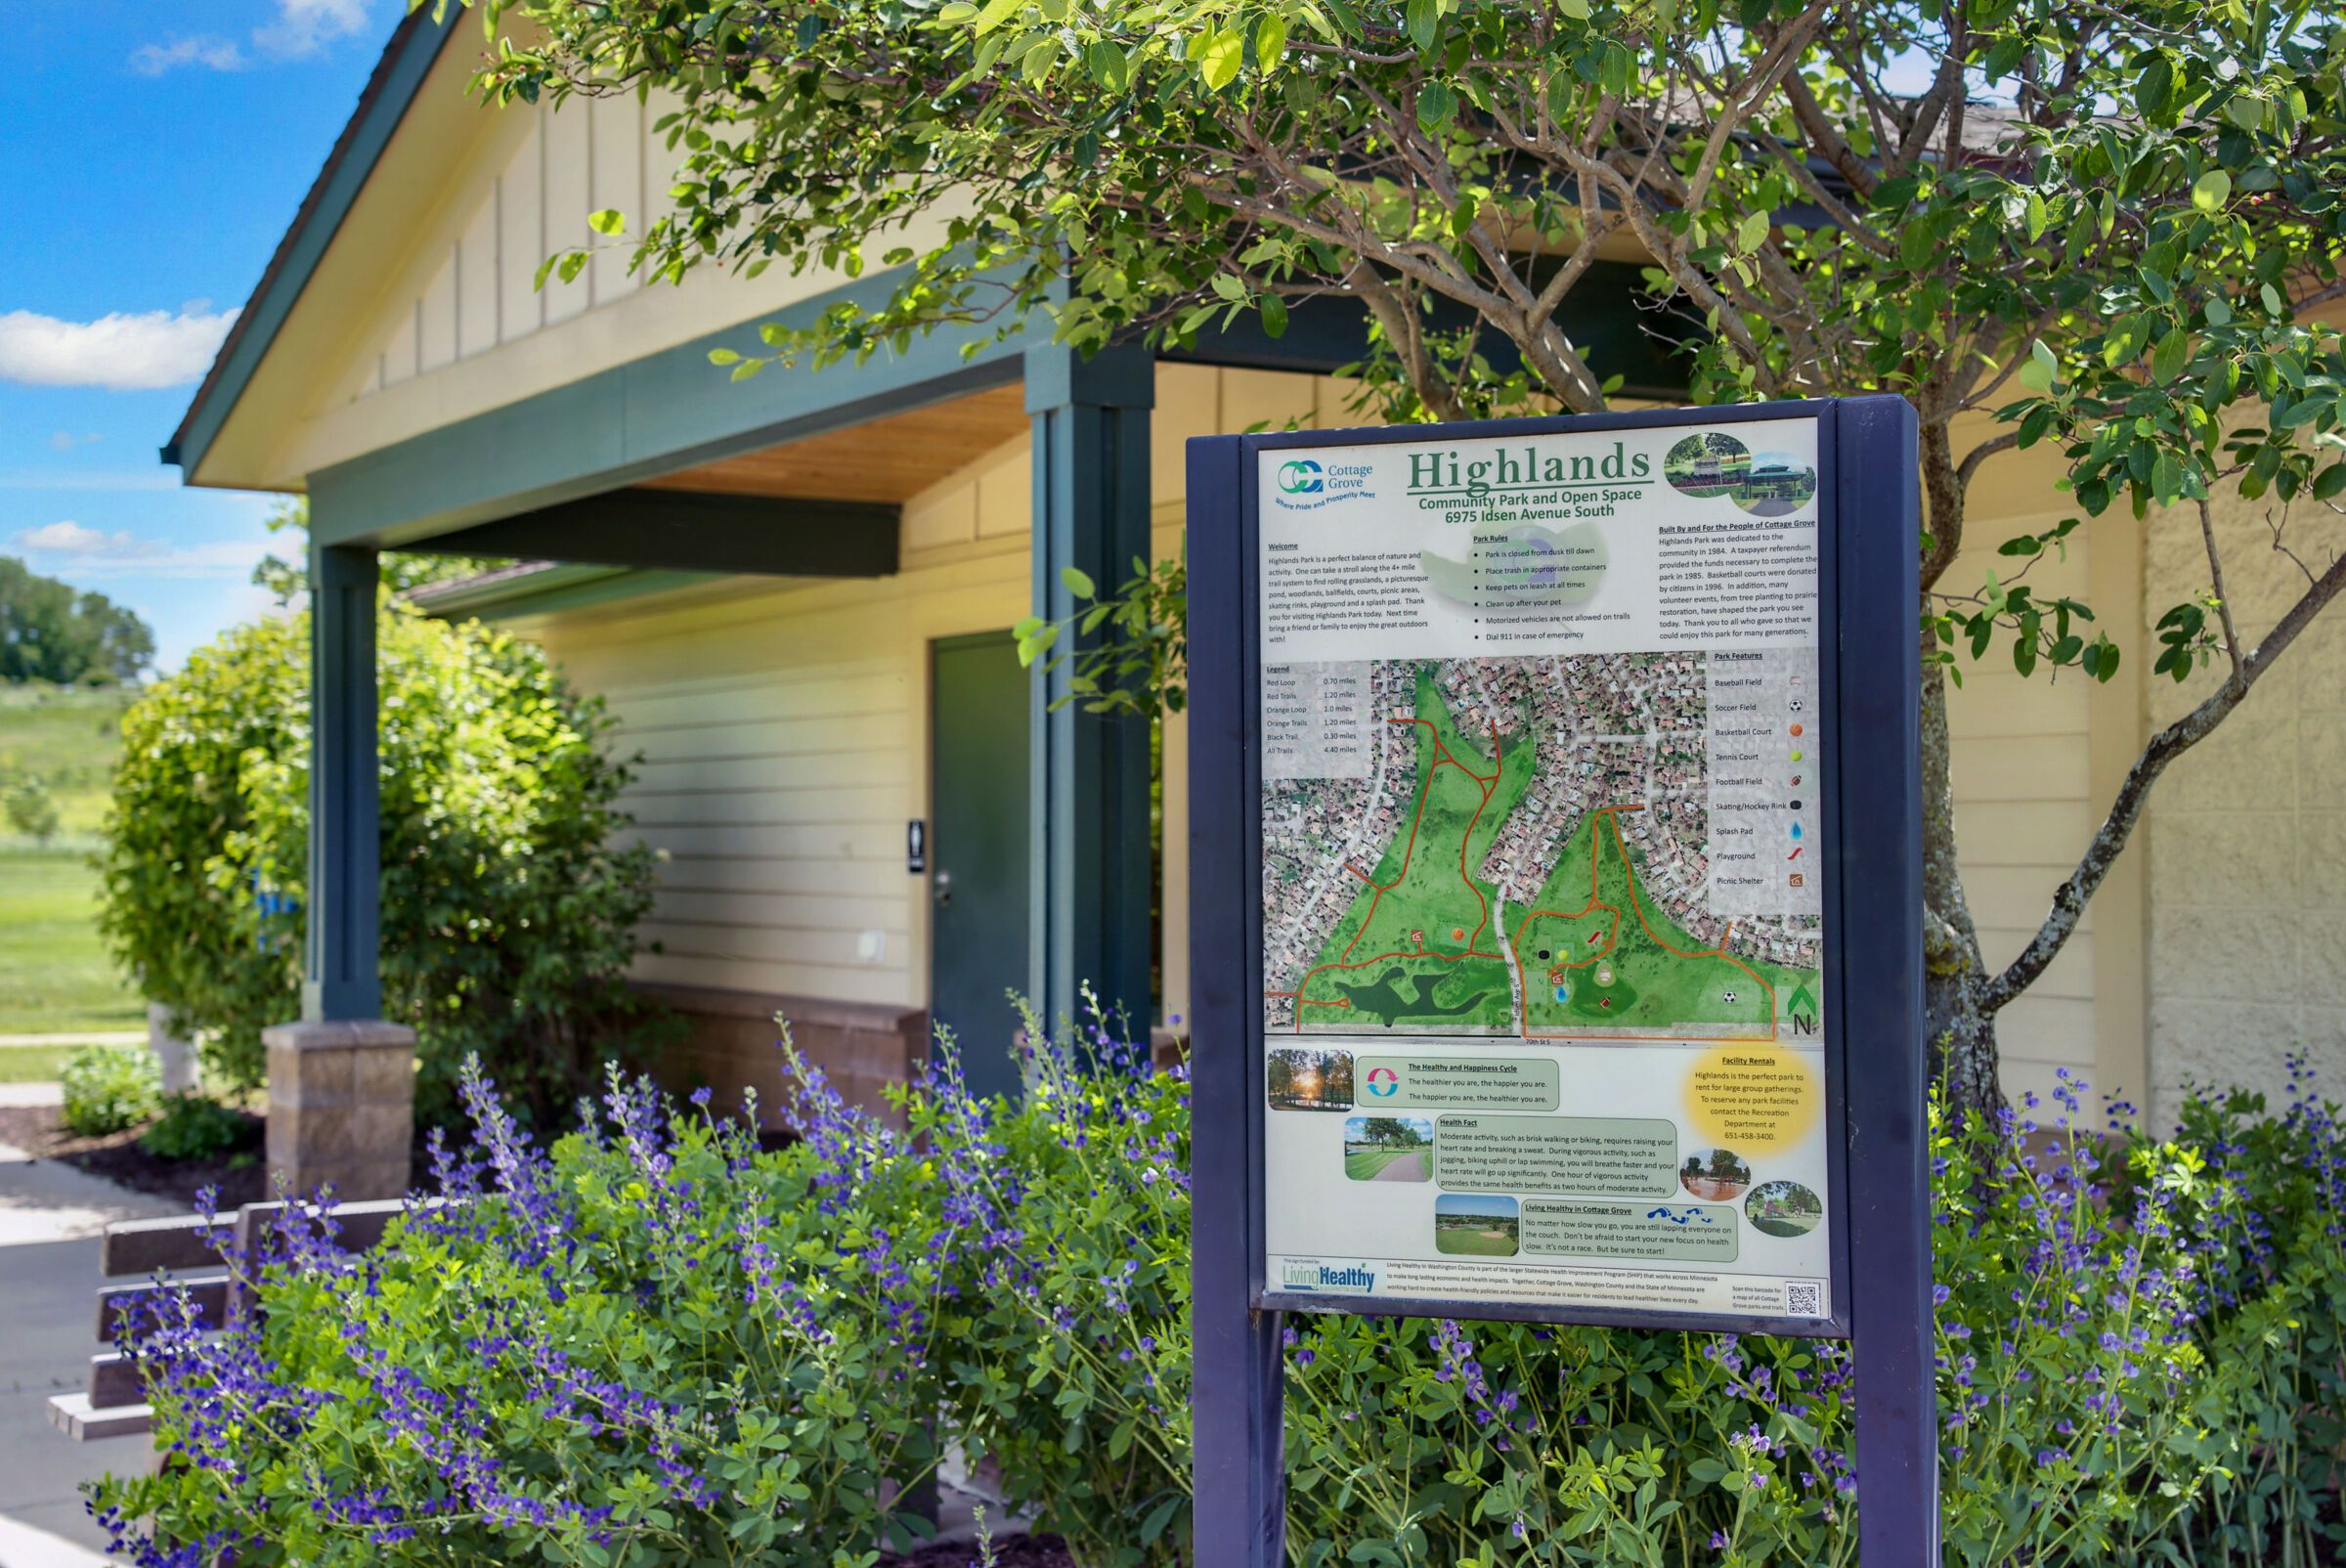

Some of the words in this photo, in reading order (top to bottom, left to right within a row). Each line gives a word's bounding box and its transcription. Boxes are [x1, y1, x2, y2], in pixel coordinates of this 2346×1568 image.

[1328, 463, 1373, 480] Cottage
[1408, 442, 1650, 498] Highlands
[1328, 476, 1364, 489] Grove
[1275, 497, 1294, 510] Where
[1326, 491, 1358, 504] Prosperity
[1419, 496, 1495, 510] Community
[1499, 493, 1528, 507] Park
[1532, 492, 1557, 505] and
[1561, 490, 1598, 508] Open
[1602, 489, 1642, 503] Space
[1446, 510, 1477, 524] 6975
[1481, 508, 1516, 522] Idsen
[1520, 506, 1571, 521] Avenue
[1574, 504, 1614, 518] South
[1659, 525, 1675, 534] Built
[1676, 525, 1686, 534] By
[1687, 524, 1701, 532] and
[1702, 524, 1714, 532] For
[1715, 523, 1728, 531] the
[1729, 522, 1754, 531] People
[1764, 520, 1792, 530] Cottage
[1793, 519, 1815, 528] Grove
[1268, 543, 1298, 551] Welcome
[1530, 565, 1570, 575] appropriate
[1269, 590, 1287, 600] pond,
[1287, 589, 1324, 599] woodlands,
[1325, 588, 1355, 598] ballfields,
[1356, 588, 1379, 597] courts,
[1380, 587, 1399, 596] picnic
[1400, 587, 1420, 596] areas,
[1532, 600, 1548, 608] your
[1549, 599, 1561, 608] pet
[1486, 616, 1520, 624] Motorized
[1267, 665, 1289, 674] Legend
[1279, 679, 1295, 687] Loop
[1266, 706, 1290, 715] Orange
[1290, 706, 1307, 714] Loop
[1267, 720, 1290, 728] Orange
[1716, 802, 1769, 811] Skating/Hockey
[1716, 827, 1739, 836] Splash
[1717, 852, 1755, 861] Playground
[1794, 1014, 1810, 1035] N
[1722, 1057, 1747, 1066] Facility
[1748, 1057, 1775, 1065] Rentals
[1421, 1064, 1448, 1072] Healthy
[1463, 1065, 1498, 1073] Happiness
[1499, 1065, 1517, 1073] Cycle
[1493, 1080, 1519, 1089] happier
[1722, 1084, 1740, 1093] large
[1764, 1085, 1803, 1094] gatherings.
[1752, 1096, 1768, 1106] park
[1724, 1120, 1767, 1129] Department
[1473, 1134, 1499, 1143] activity,
[1543, 1135, 1569, 1145] walking
[1579, 1136, 1602, 1145] biking,
[1603, 1137, 1632, 1146] requires
[1633, 1138, 1656, 1147] raising
[1725, 1132, 1775, 1140] 651-458-3400.
[1525, 1204, 1545, 1213] Living
[1547, 1205, 1573, 1215] Healthy
[1582, 1206, 1609, 1216] Cottage
[1610, 1207, 1632, 1215] Grove
